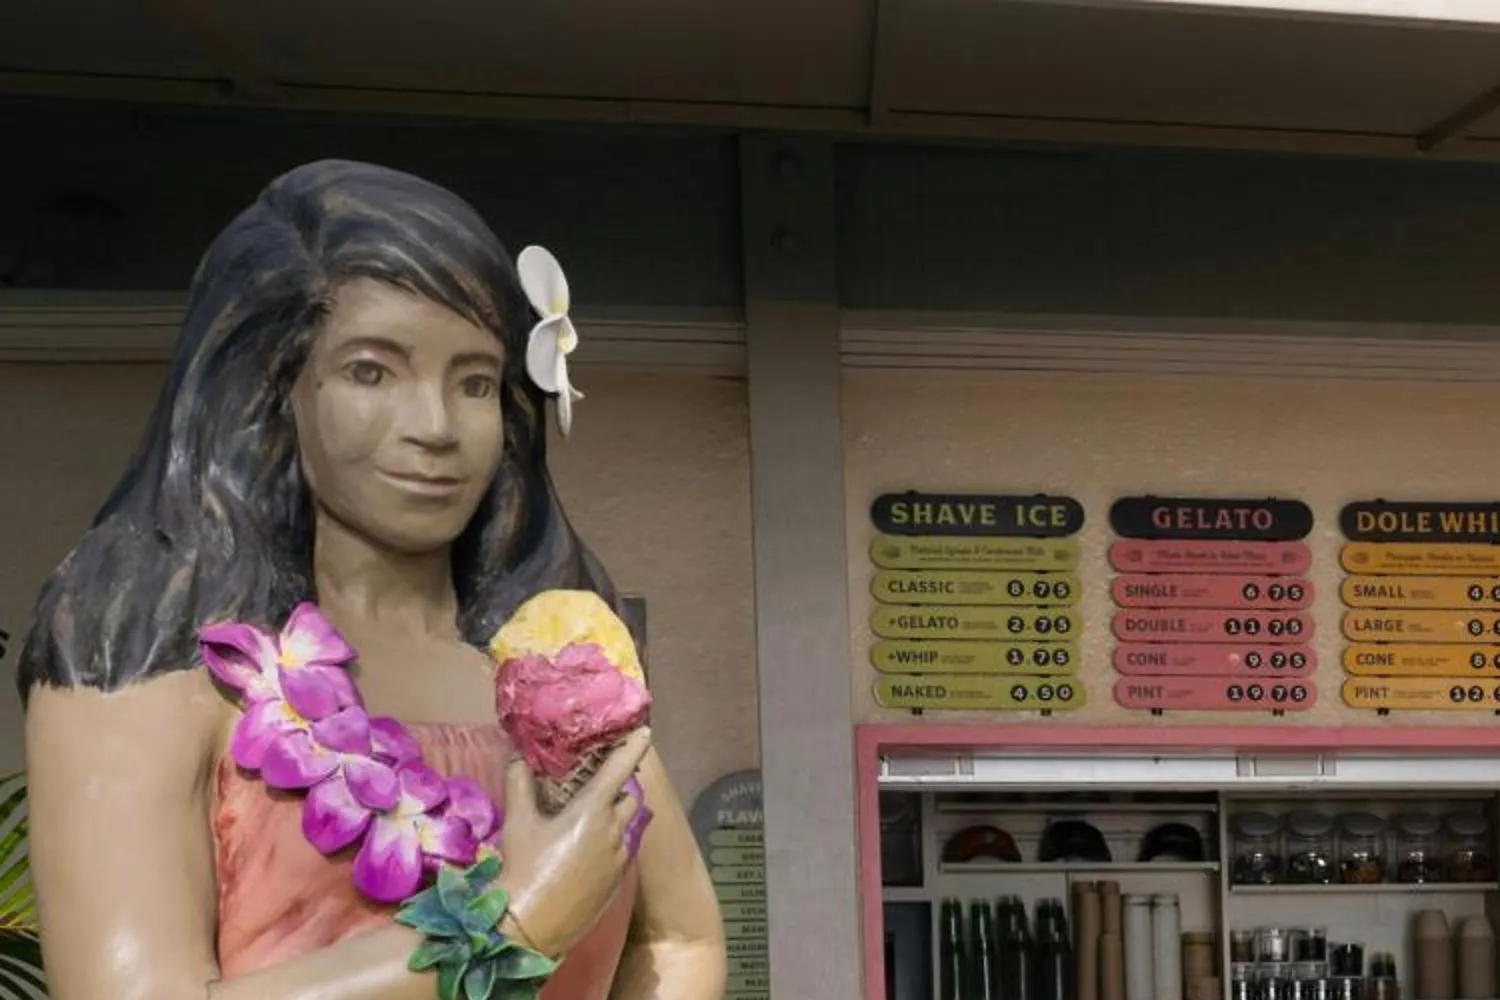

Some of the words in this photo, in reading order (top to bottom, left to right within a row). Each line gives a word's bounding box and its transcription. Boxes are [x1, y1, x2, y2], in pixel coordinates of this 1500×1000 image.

[889, 502, 997, 525] SHAVE
[1016, 505, 1068, 527] ICE
[1152, 506, 1273, 530] GELATO
[1357, 511, 1432, 532] DOLE
[888, 579, 955, 594] CLASSIC
[1125, 583, 1178, 598] SINGLE
[1354, 584, 1405, 599] SMALL
[1125, 618, 1186, 632] DOUBLE
[1354, 619, 1404, 633] LARGE
[1127, 652, 1168, 666] CONE
[1355, 653, 1396, 666] CONE
[891, 685, 947, 699] NAKED
[1127, 684, 1165, 699] PINT
[1354, 686, 1390, 699] PINT
